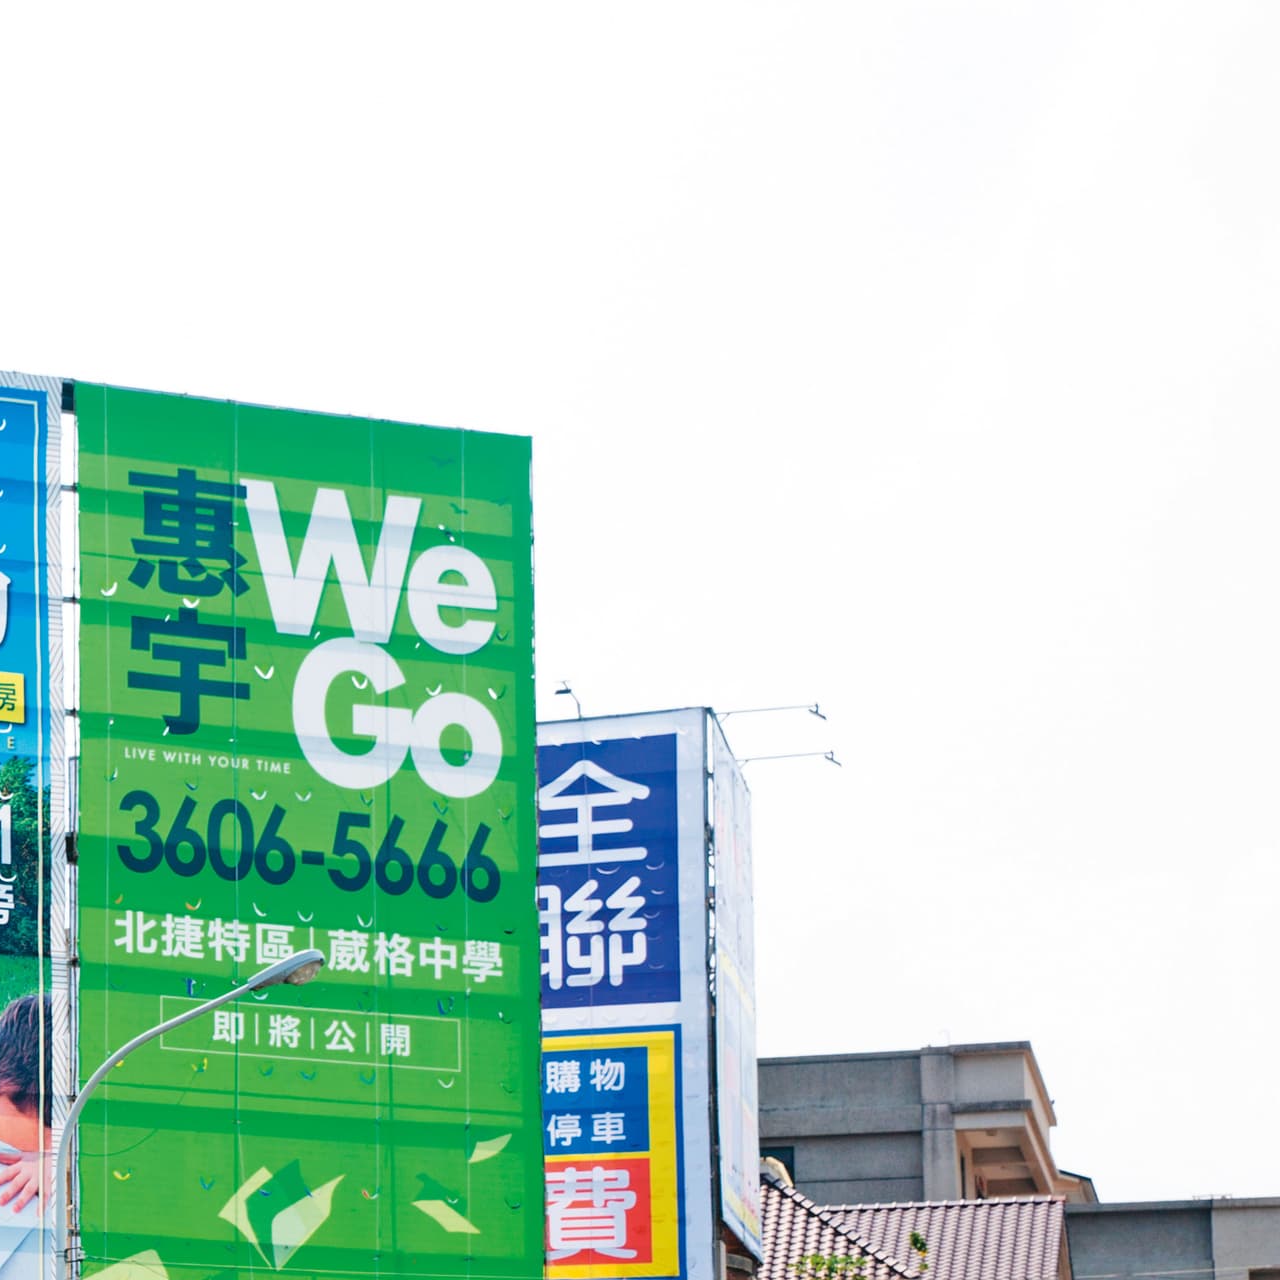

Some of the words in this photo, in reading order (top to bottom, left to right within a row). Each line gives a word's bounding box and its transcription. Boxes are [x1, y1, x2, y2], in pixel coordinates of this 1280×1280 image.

[127, 468, 251, 735] 惠宇
[239, 477, 497, 655] We
[124, 747, 156, 761] LIVE
[163, 751, 201, 765] WITH
[208, 755, 249, 769] YOUR
[256, 760, 291, 774] TIME
[292, 636, 503, 799] Go
[117, 790, 501, 903] 3606-5666
[114, 910, 295, 966] 北捷特區
[327, 930, 504, 984] 葳格中學
[546, 1058, 627, 1096] 購物
[546, 1112, 627, 1148] 停車
